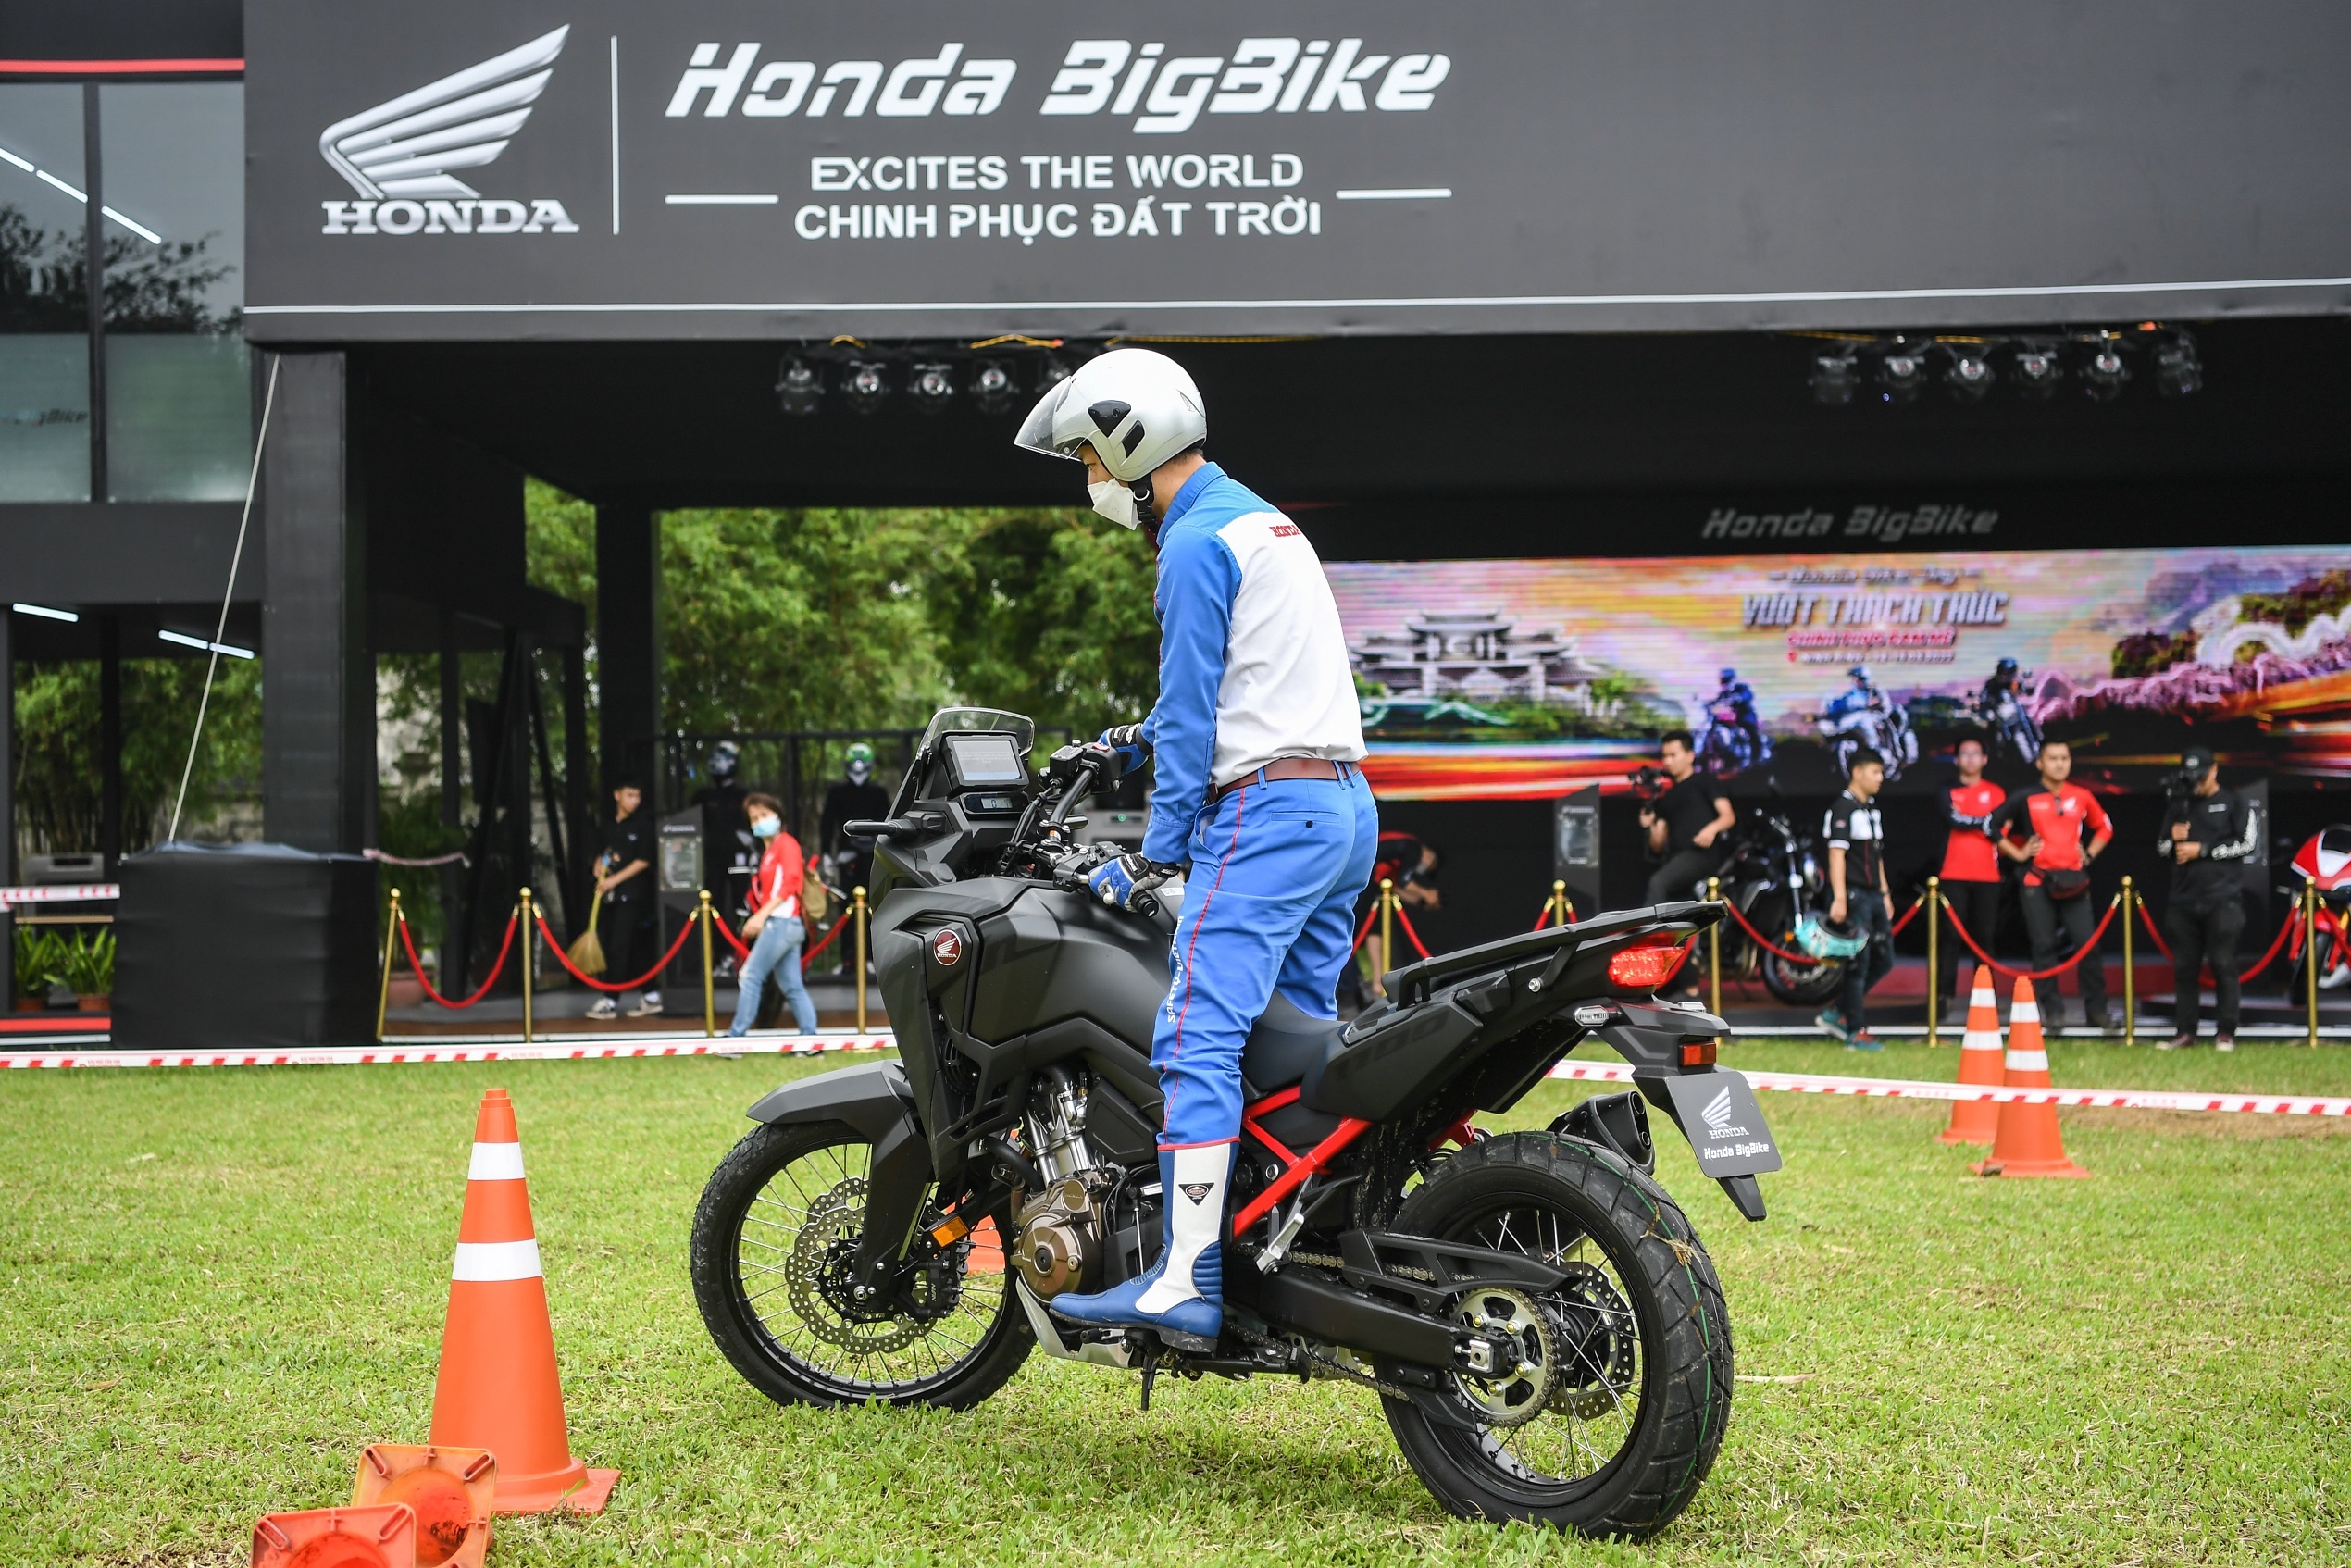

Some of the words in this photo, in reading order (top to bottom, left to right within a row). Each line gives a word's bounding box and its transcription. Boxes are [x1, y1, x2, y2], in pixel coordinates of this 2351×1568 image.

[665, 42, 1017, 118] Honda
[1039, 38, 1451, 134] BigBike
[811, 156, 1008, 191] EXCITES
[1019, 155, 1114, 190] THE
[1126, 153, 1304, 189] WORLD
[321, 199, 580, 235] HONDA
[794, 204, 938, 240] CHINH
[949, 203, 1078, 246] PHỤC
[1090, 194, 1192, 237] ĐẤT
[1205, 194, 1321, 236] TRỜI
[1701, 506, 1835, 539] Honda
[1843, 504, 1999, 543] BigBike
[1704, 1145, 1734, 1159] Honda
[1735, 1142, 1770, 1158] BigBike
[1708, 1126, 1749, 1139] HONDA
